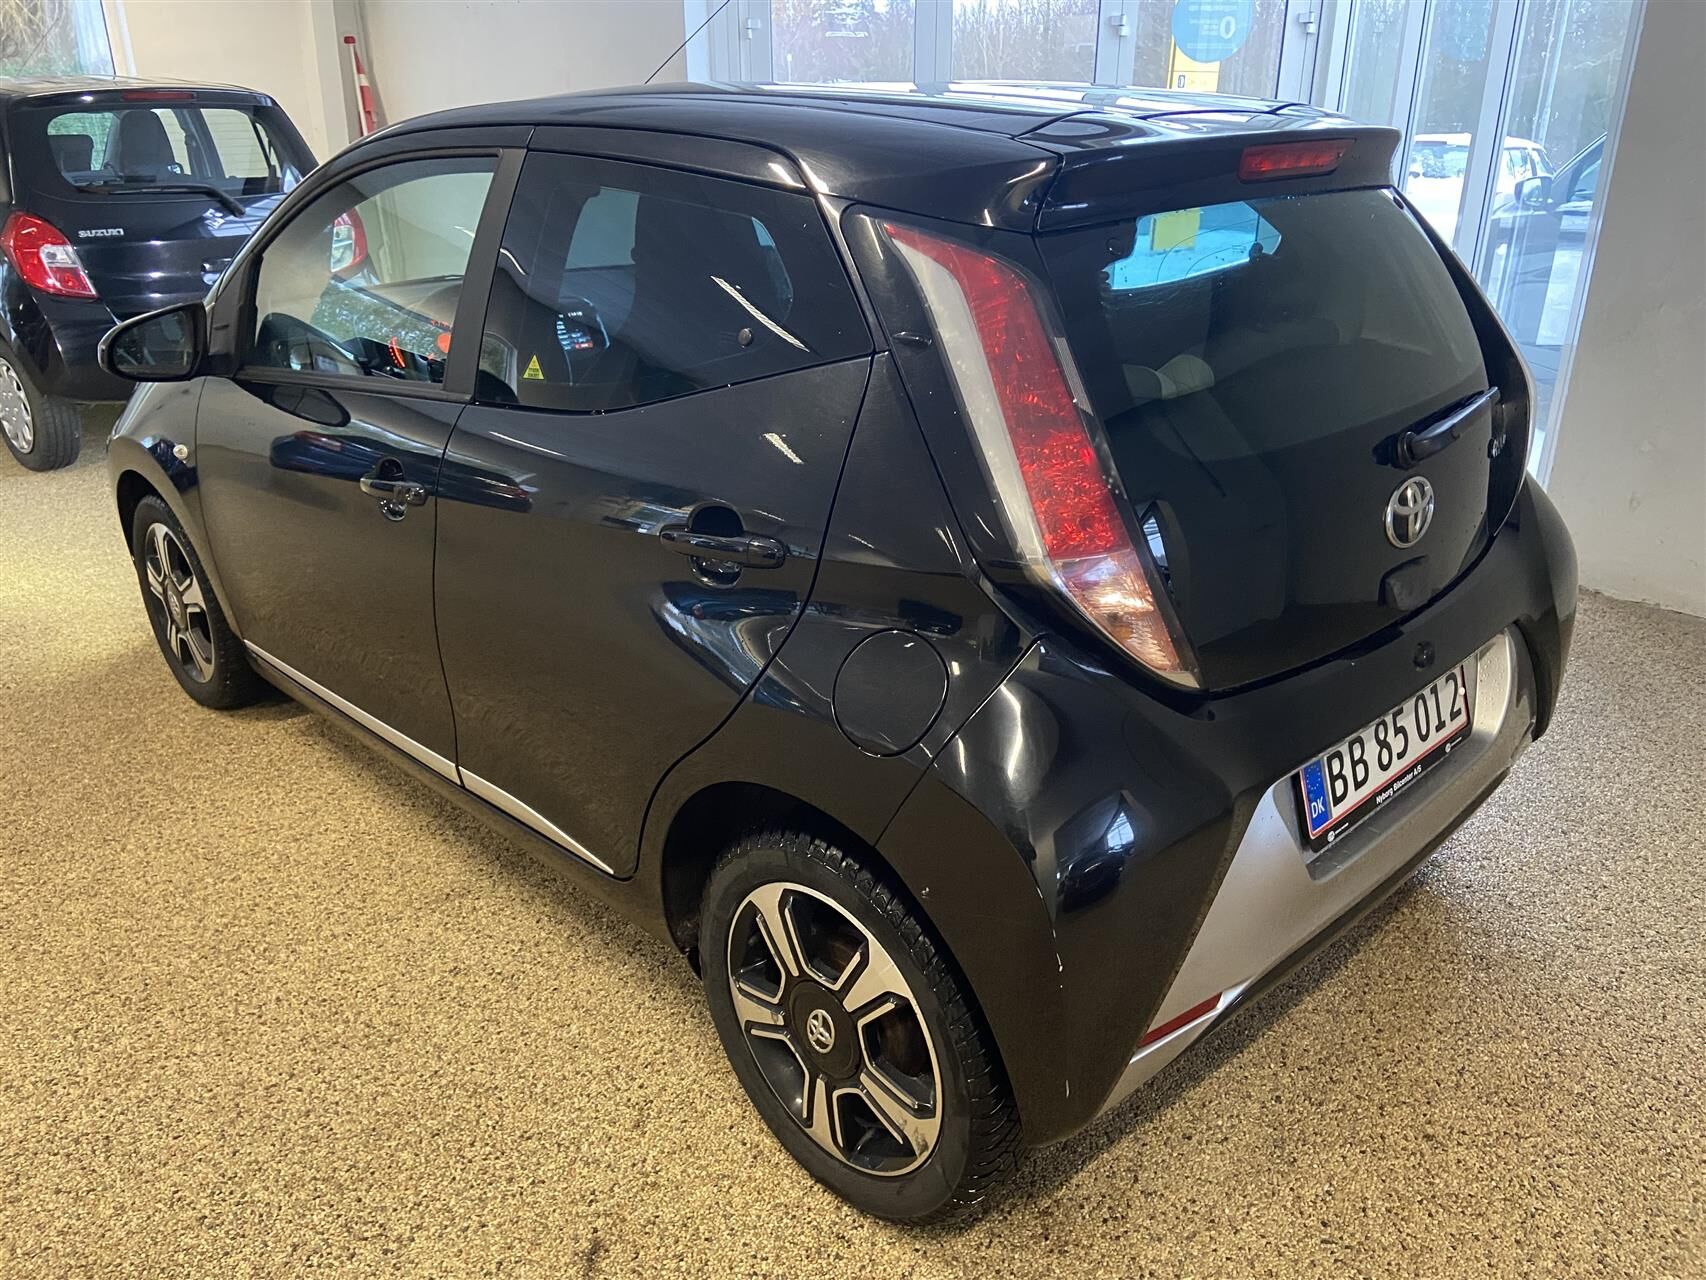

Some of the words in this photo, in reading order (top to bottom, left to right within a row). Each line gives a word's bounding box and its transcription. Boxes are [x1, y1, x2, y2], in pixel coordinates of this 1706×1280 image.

[1326, 735, 1369, 807] BB
[1374, 706, 1409, 772] 85
[1414, 671, 1462, 742] 012
[1376, 787, 1393, 804] Nyborg
[1393, 772, 1413, 791] Bilcenter
[1413, 764, 1422, 776] A/S
[1311, 797, 1325, 818] DK
